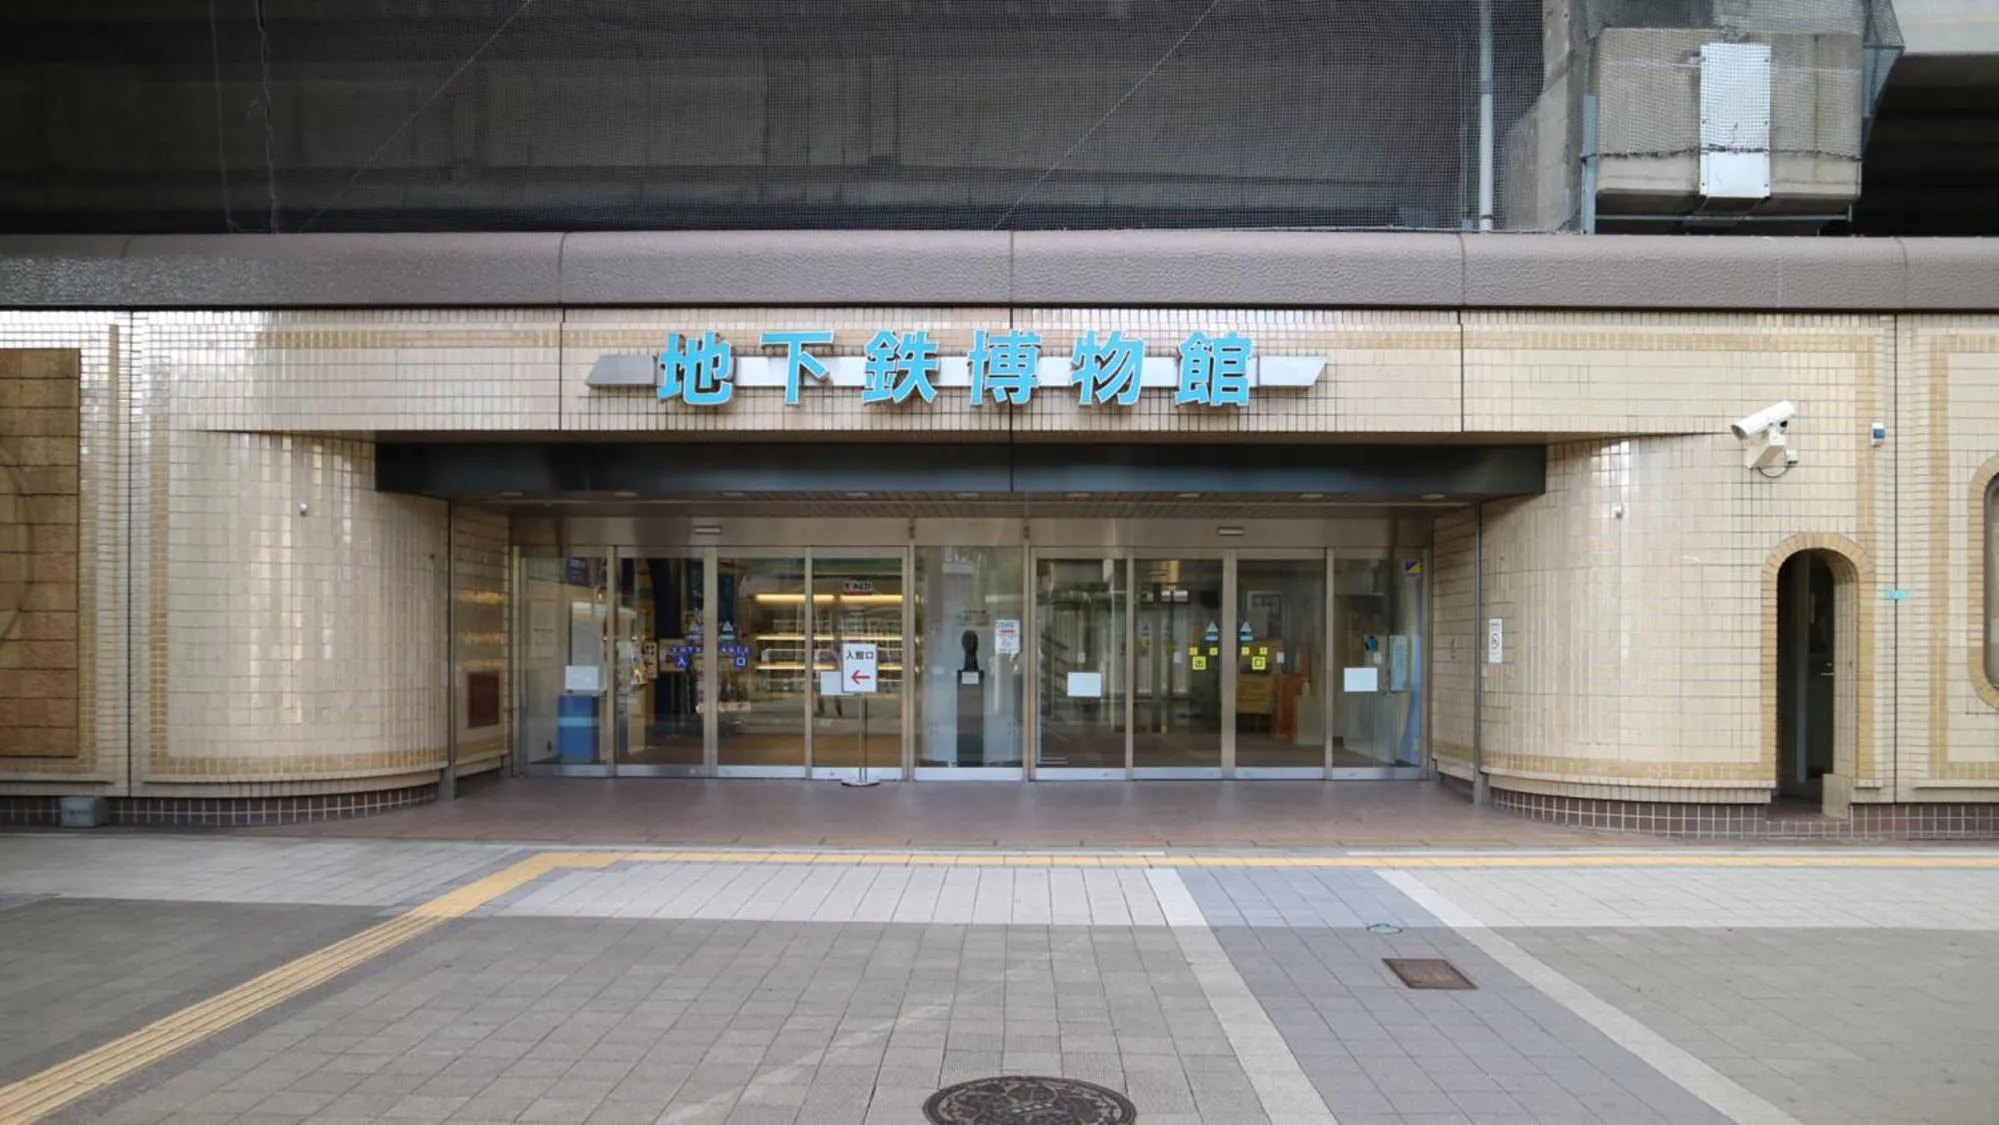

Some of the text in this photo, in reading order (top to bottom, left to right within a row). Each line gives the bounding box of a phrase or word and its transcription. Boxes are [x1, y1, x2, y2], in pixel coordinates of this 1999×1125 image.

[657, 329, 1254, 407] 地下鉄博物館
[846, 650, 874, 660] 入館口
